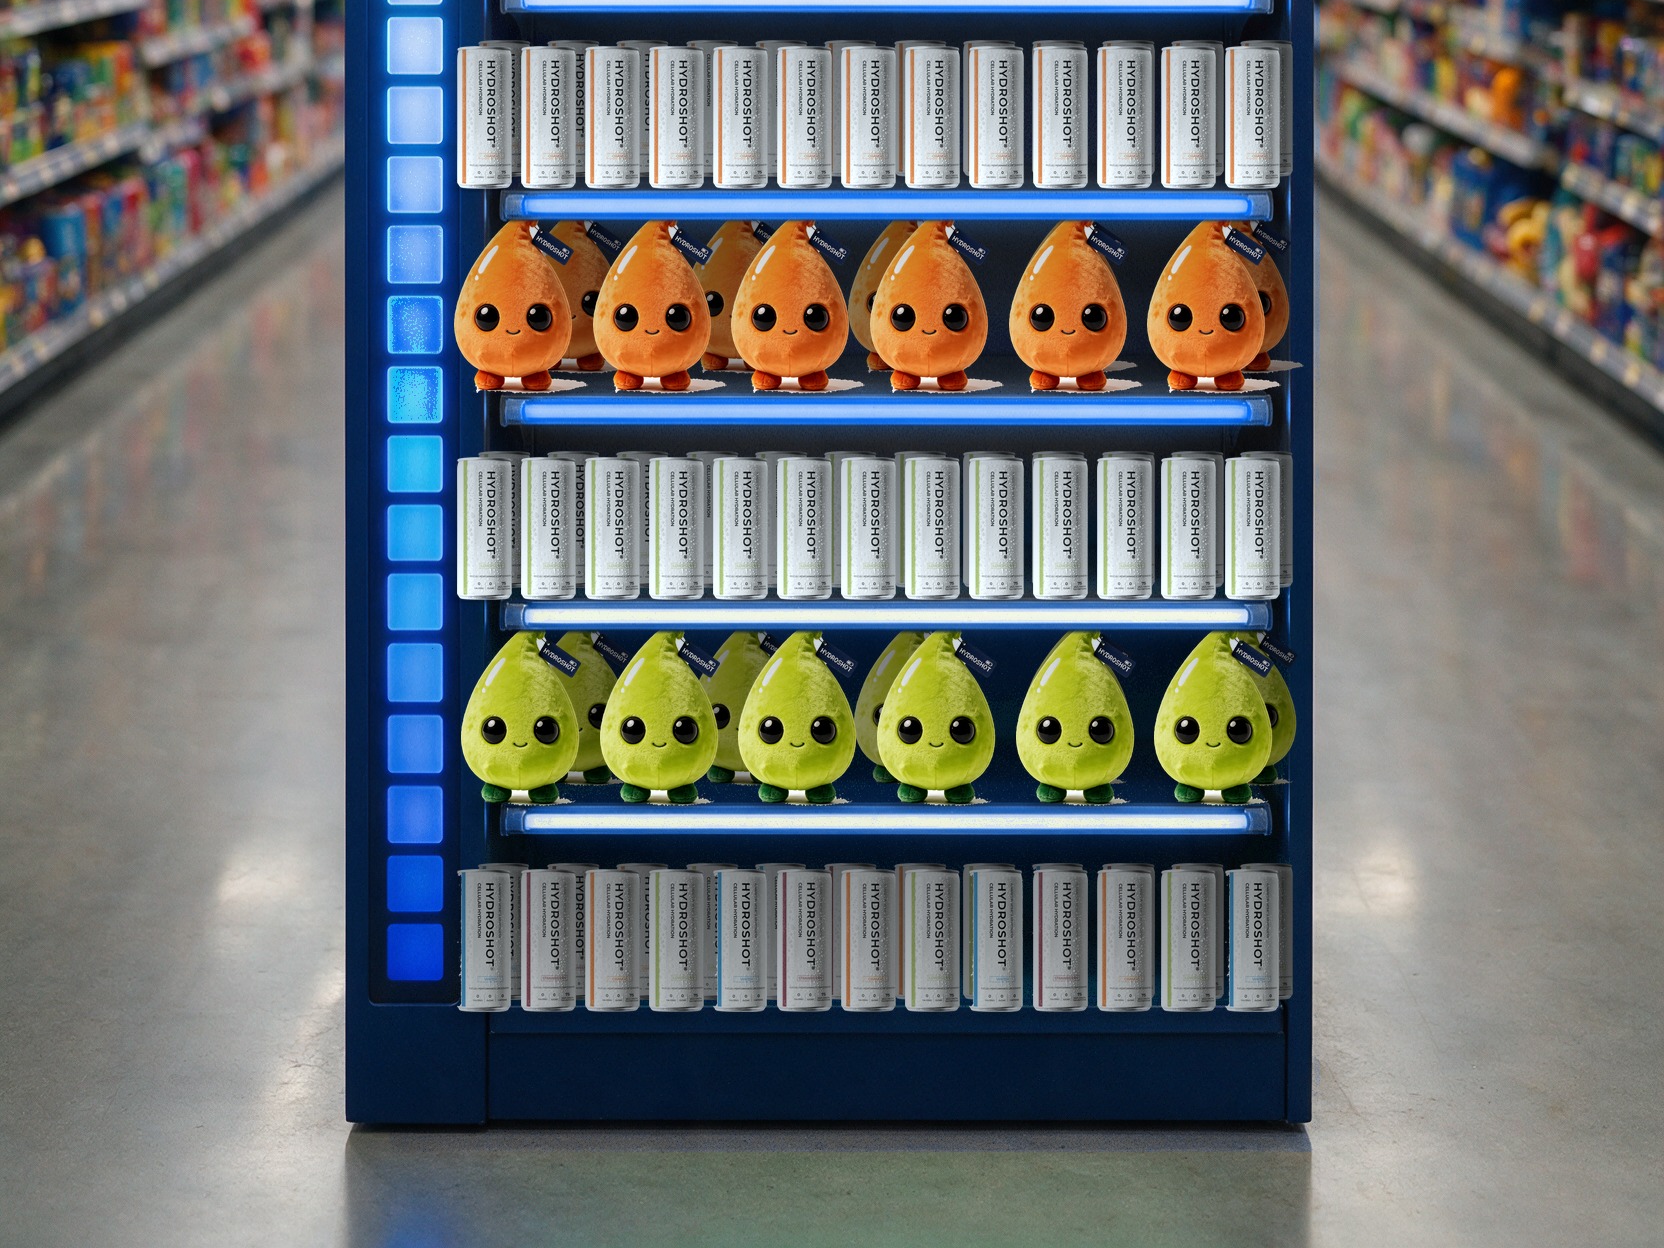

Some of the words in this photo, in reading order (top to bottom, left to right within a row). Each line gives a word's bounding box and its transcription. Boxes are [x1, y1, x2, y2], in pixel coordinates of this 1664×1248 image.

[535, 235, 569, 260] HYDROSHOT
[674, 235, 708, 260] HYDROSHOT
[812, 235, 846, 260] HYDROSHOT
[951, 235, 985, 260] HYDROSHOT
[1090, 235, 1124, 260] HYDROSHOT
[1228, 235, 1262, 260] HYDROSHOT
[542, 647, 576, 672] HYDROSHOT
[681, 647, 715, 672] HYDROSHOT
[819, 647, 853, 672] HYDROSHOT
[958, 647, 992, 672] HYDROSHOT
[1097, 647, 1131, 672] HYDROSHOT
[1235, 647, 1269, 672] HYDROSHOT
